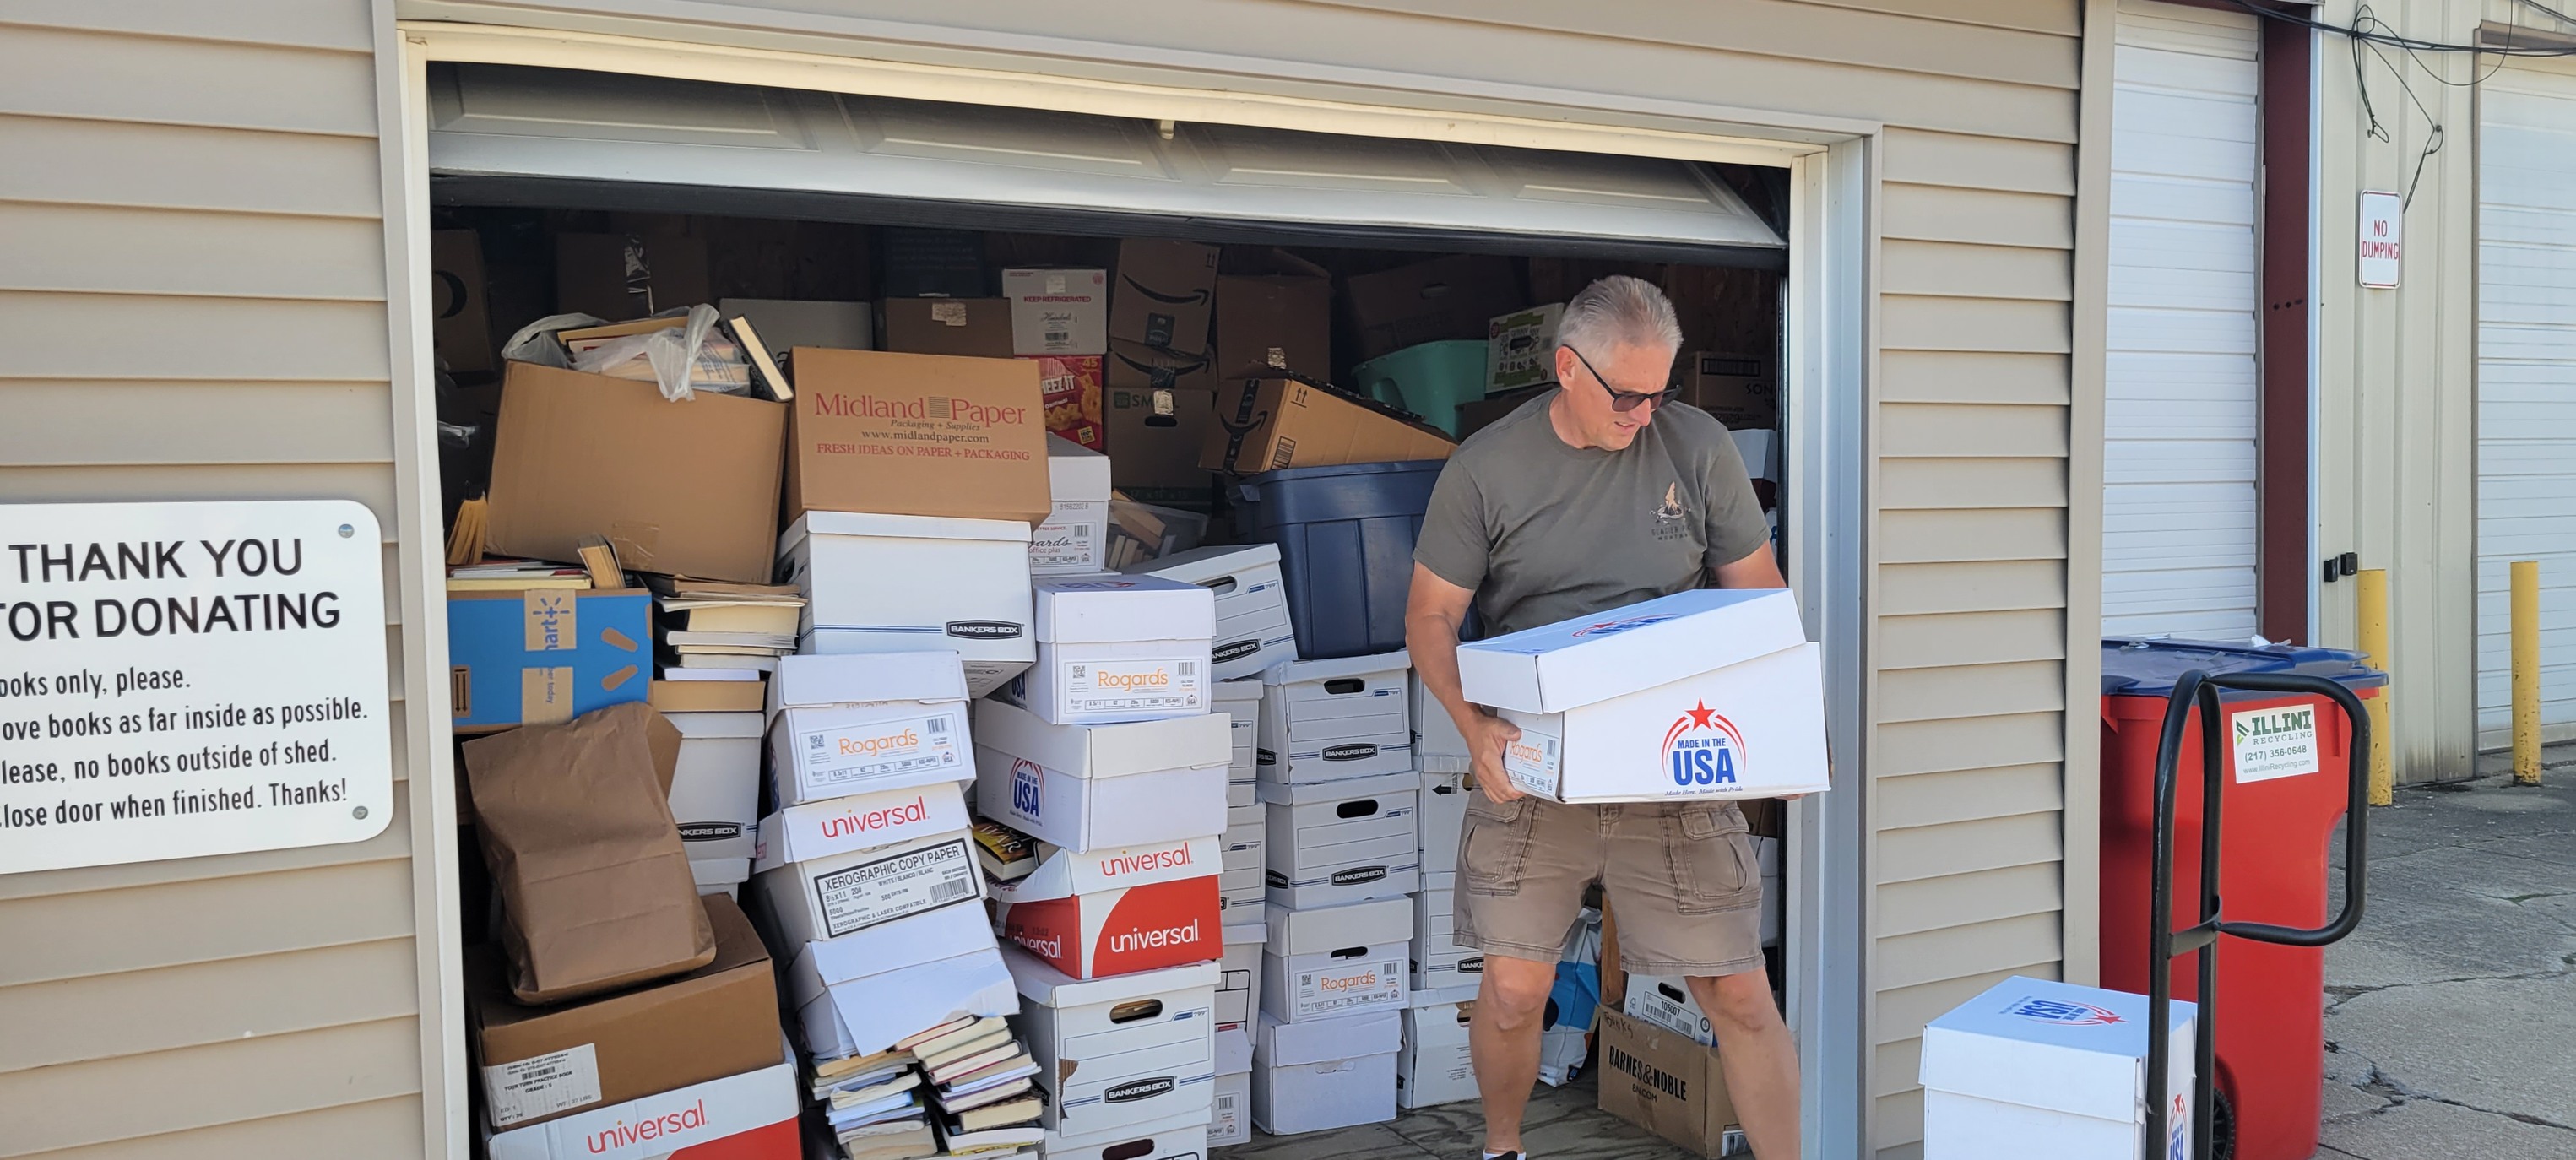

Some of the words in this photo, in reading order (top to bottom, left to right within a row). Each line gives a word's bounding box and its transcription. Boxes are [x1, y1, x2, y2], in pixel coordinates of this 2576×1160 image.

[2373, 220, 2388, 237] NO
[2362, 241, 2399, 260] DUMPING
[815, 393, 925, 420] Midland
[950, 398, 1026, 428] Paper
[891, 419, 935, 430] Packaging
[946, 421, 980, 431] Supplies
[862, 429, 990, 444] www.midlandpaper.com
[816, 443, 855, 455] FRESH
[859, 445, 893, 456] IDEAS
[897, 446, 914, 456] ON
[917, 446, 952, 458] PAPER
[964, 450, 1030, 461] PACKAGING
[8, 540, 188, 583] THANK
[200, 538, 302, 577] YOU
[0, 600, 80, 642] OR
[95, 591, 341, 638] DONATING
[1212, 648, 1240, 659] ANKERS
[1241, 642, 1257, 652] BOX
[56, 669, 107, 699] only,
[117, 666, 191, 698] please.
[1098, 668, 1169, 691] Rogards
[48, 713, 113, 739] books
[119, 715, 142, 734] as
[149, 707, 178, 732] far
[185, 703, 247, 729] inside
[253, 706, 275, 725] as
[281, 697, 368, 729] possible.
[2252, 710, 2312, 736] ILLINI
[838, 729, 919, 756] Rogards
[1678, 740, 1700, 749] MADE
[1702, 739, 1710, 747] IN
[1712, 738, 1726, 747] THE
[2253, 731, 2313, 745] RECYCLING
[74, 760, 99, 780] no
[107, 750, 170, 778] books
[177, 745, 252, 772] outside
[260, 741, 279, 766] of
[285, 738, 337, 764] shed.
[1326, 748, 1359, 756] BANKERS
[2244, 751, 2267, 763] (217)
[2270, 745, 2307, 758] 356-0648
[1017, 771, 1027, 782] MADE
[1673, 748, 1736, 786] USA
[0, 804, 47, 828] lose
[55, 799, 103, 824] door
[110, 794, 165, 819] when
[172, 784, 262, 816] finished.
[268, 778, 348, 806] Thanks!
[1013, 779, 1039, 817] USA
[822, 795, 925, 838] universal
[825, 862, 898, 891] XEROGRAPHIC
[898, 854, 925, 870] COPY
[927, 845, 961, 864] PAPER
[1101, 841, 1191, 876] universal
[878, 877, 895, 886] WHITE
[898, 872, 916, 882] BLANCO
[919, 867, 934, 877] BLANC
[1334, 871, 1368, 882] BANKERS
[829, 907, 843, 915] 5000
[832, 913, 870, 929] XEROGRAPHIC
[876, 908, 894, 918] LASER
[895, 898, 927, 912] COMPATIBLE
[1110, 918, 1199, 953] universal
[1321, 970, 1376, 993] Rogards
[1661, 1000, 1681, 1017] 105007
[534, 1074, 557, 1084] PRACTICE
[559, 1070, 572, 1078] BOOK
[525, 1084, 544, 1093] GRADE
[1109, 1085, 1152, 1099] BANKERS
[1152, 1081, 1172, 1090] BOX
[1632, 1083, 1657, 1103] BN.COM
[587, 1098, 706, 1154] universal
